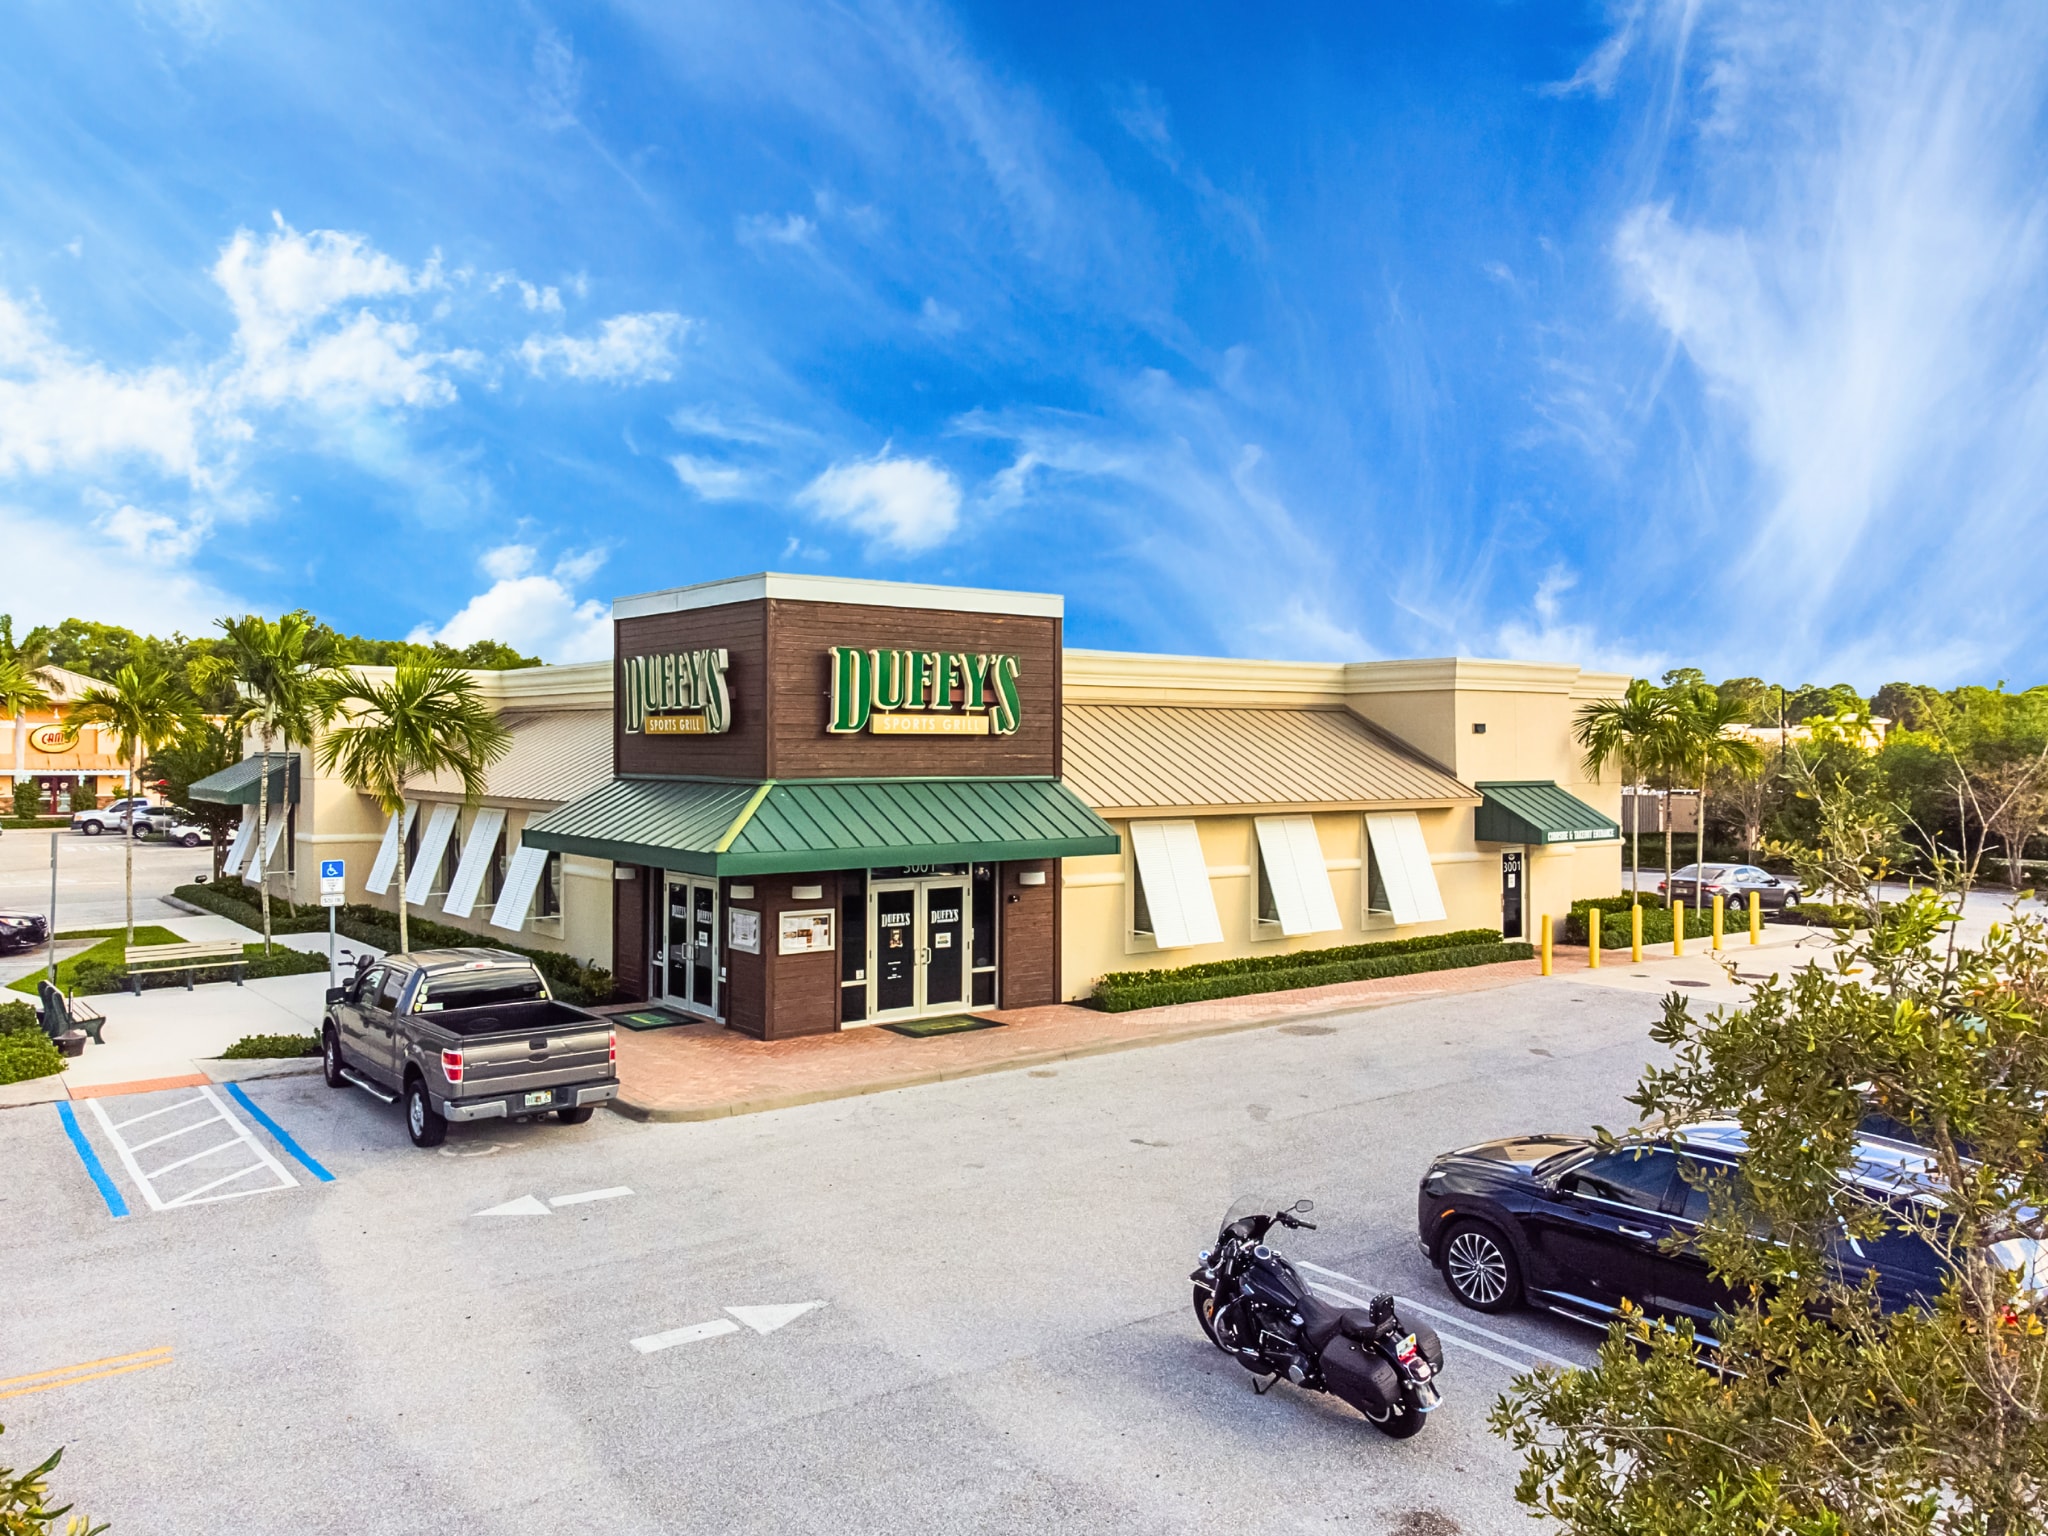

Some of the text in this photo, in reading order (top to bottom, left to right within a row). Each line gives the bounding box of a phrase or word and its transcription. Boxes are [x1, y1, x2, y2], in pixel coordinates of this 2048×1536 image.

[624, 648, 731, 735] DUFFY'S
[827, 646, 1021, 735] DUFFY'S
[649, 719, 701, 731] SPORTS GRILL
[883, 717, 980, 732] SPORTS GRILL
[1503, 860, 1521, 873] 3001
[881, 912, 911, 927] DUFFY'S
[931, 909, 959, 924] DUFFY'S
